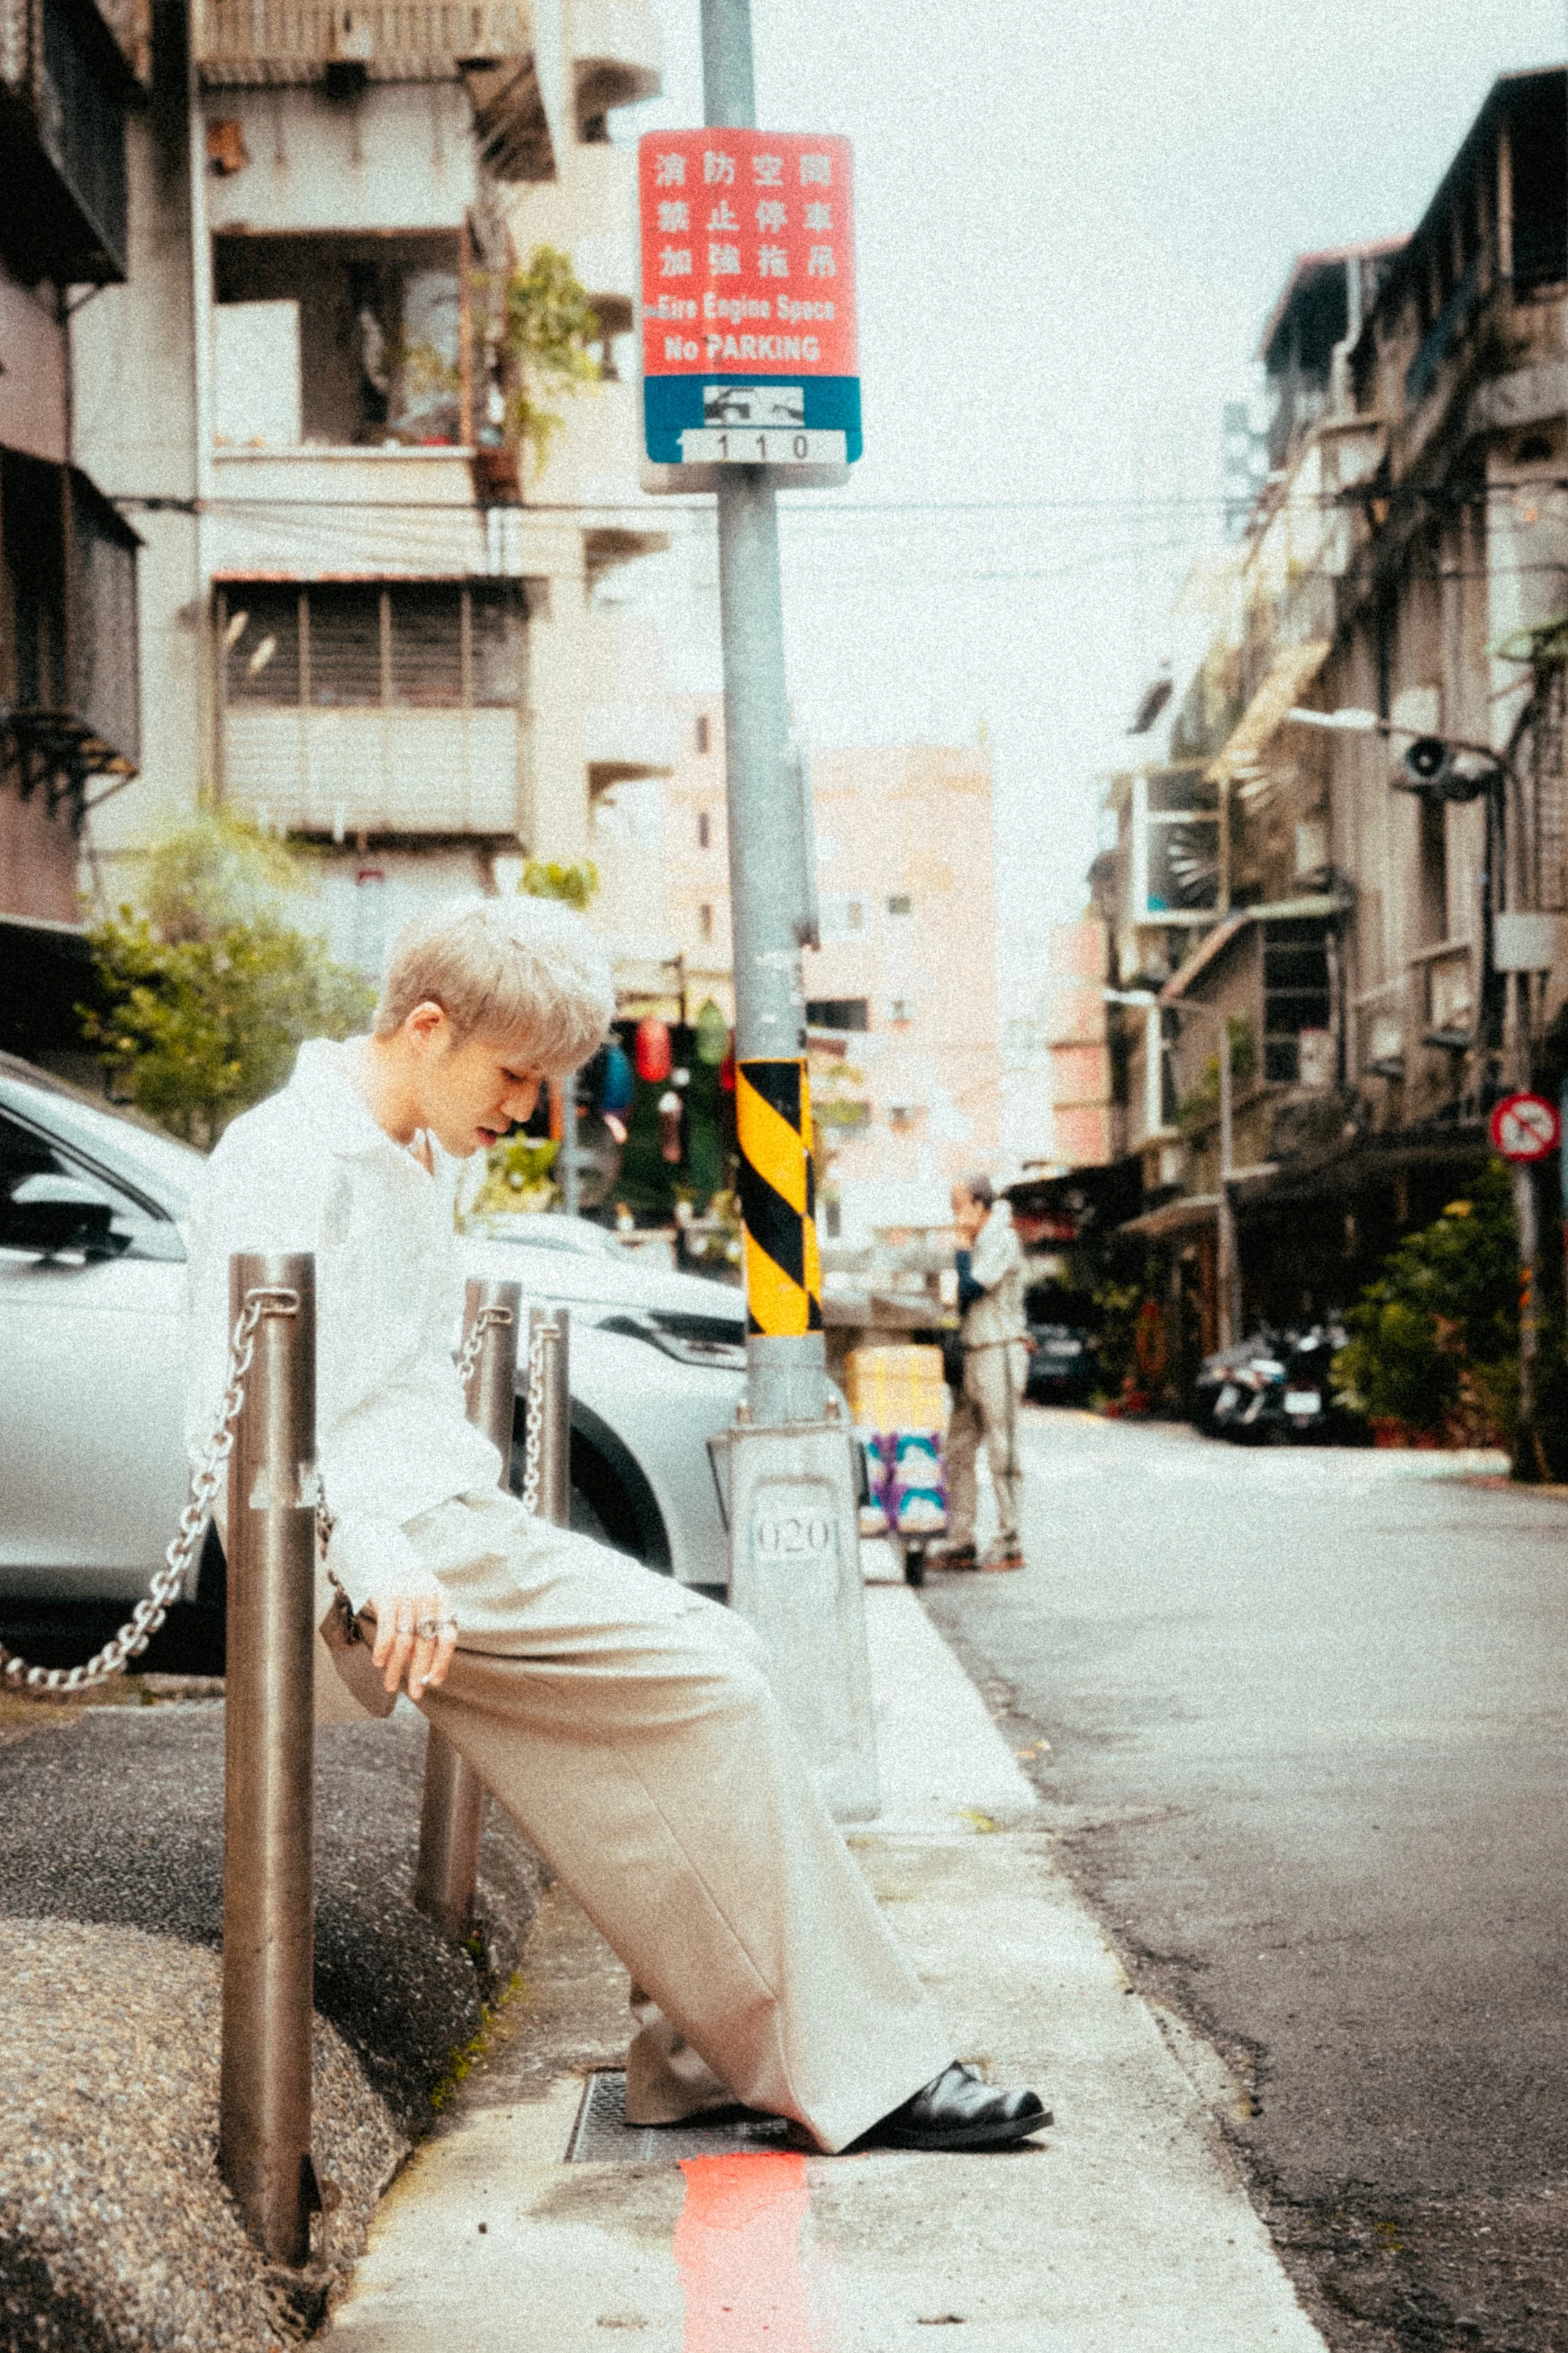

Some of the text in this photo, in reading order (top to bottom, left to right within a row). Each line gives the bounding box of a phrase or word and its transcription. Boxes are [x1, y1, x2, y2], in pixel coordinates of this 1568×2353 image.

[656, 151, 831, 185] 消防空間
[657, 199, 834, 233] 禁止停車
[659, 242, 837, 278] 加強拖吊
[658, 291, 836, 325] Fire Engine Space
[665, 334, 820, 361] No PARKING
[759, 1518, 829, 1552] 020
